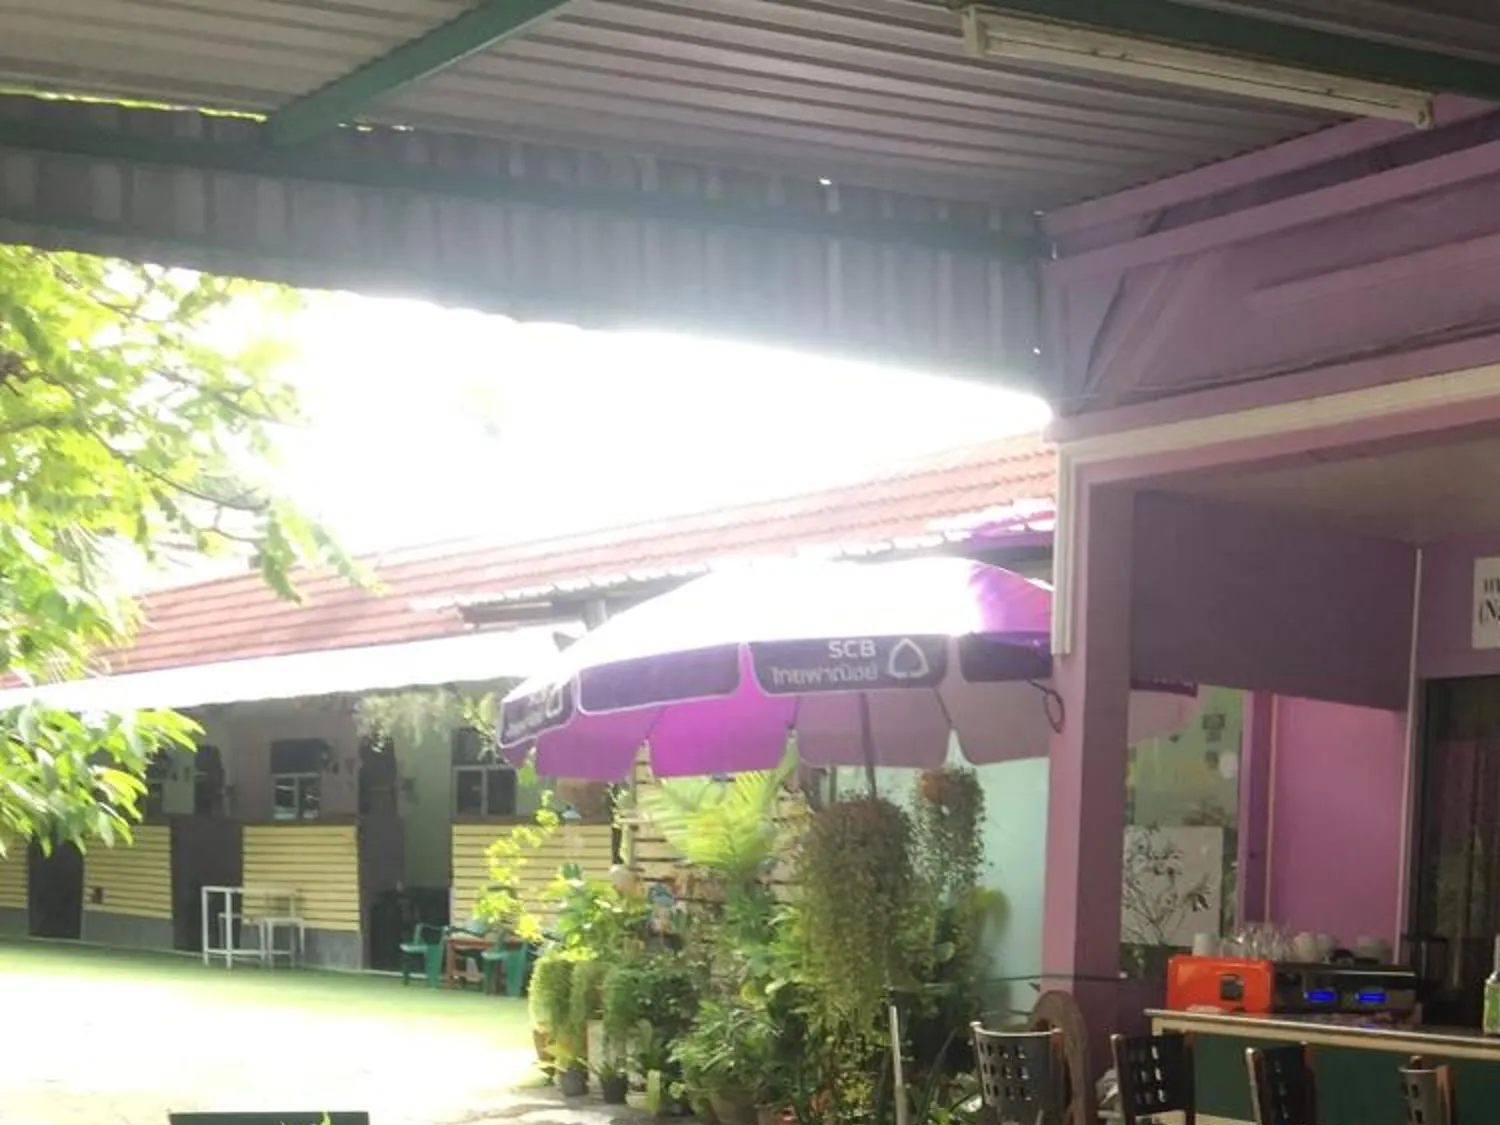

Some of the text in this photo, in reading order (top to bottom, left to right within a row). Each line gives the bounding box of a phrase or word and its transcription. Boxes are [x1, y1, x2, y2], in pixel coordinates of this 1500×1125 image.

[827, 639, 877, 659] SCB
[770, 661, 879, 687] ไทยพาณิชย์
